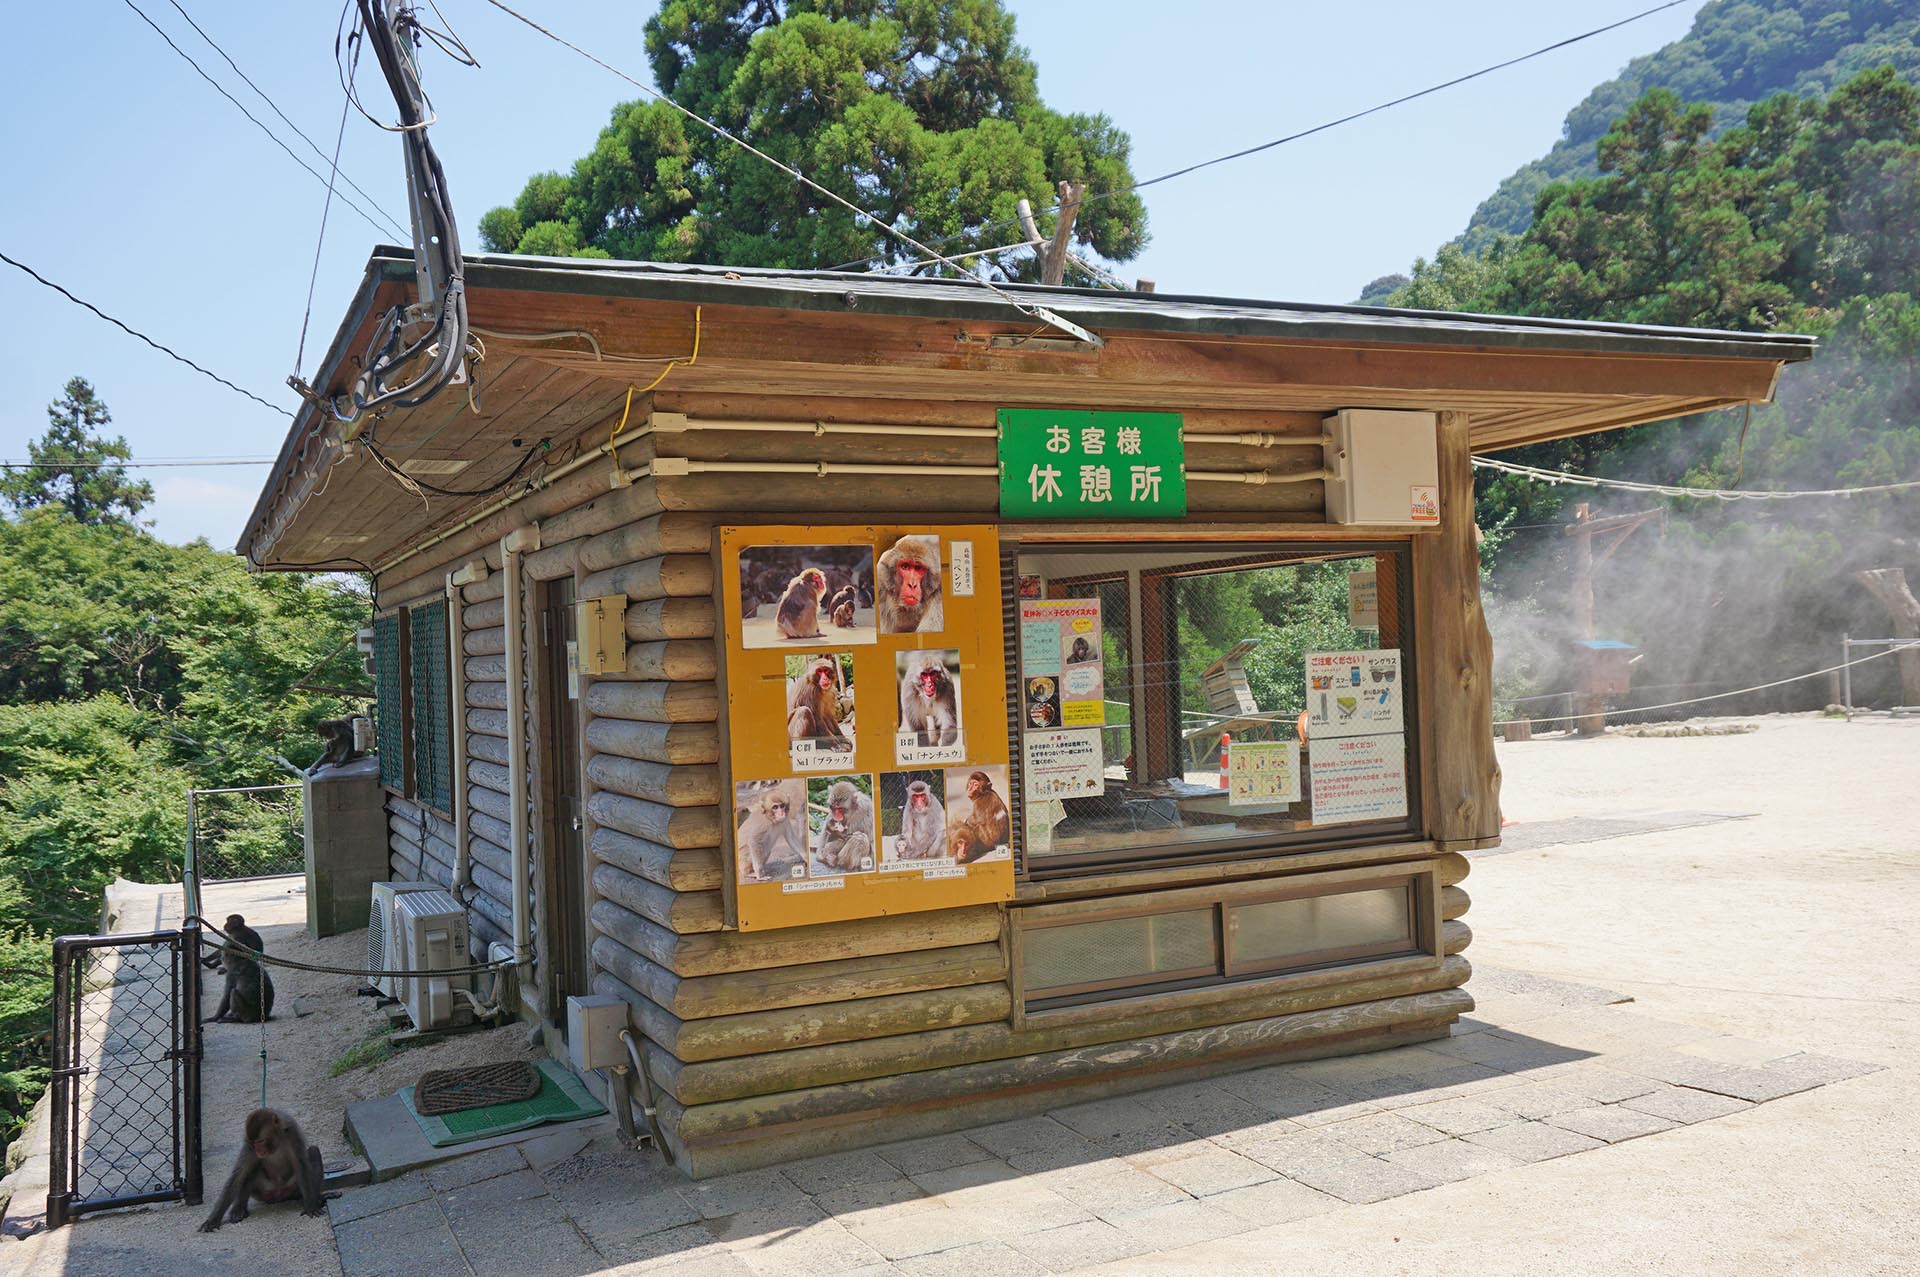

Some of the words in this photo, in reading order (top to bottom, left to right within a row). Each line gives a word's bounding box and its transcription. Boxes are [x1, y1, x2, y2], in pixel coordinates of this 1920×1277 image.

[1046, 425, 1142, 455] お客様
[1028, 463, 1162, 503] 休憩所
[1368, 657, 1397, 665] サングラス
[796, 743, 811, 753] C群
